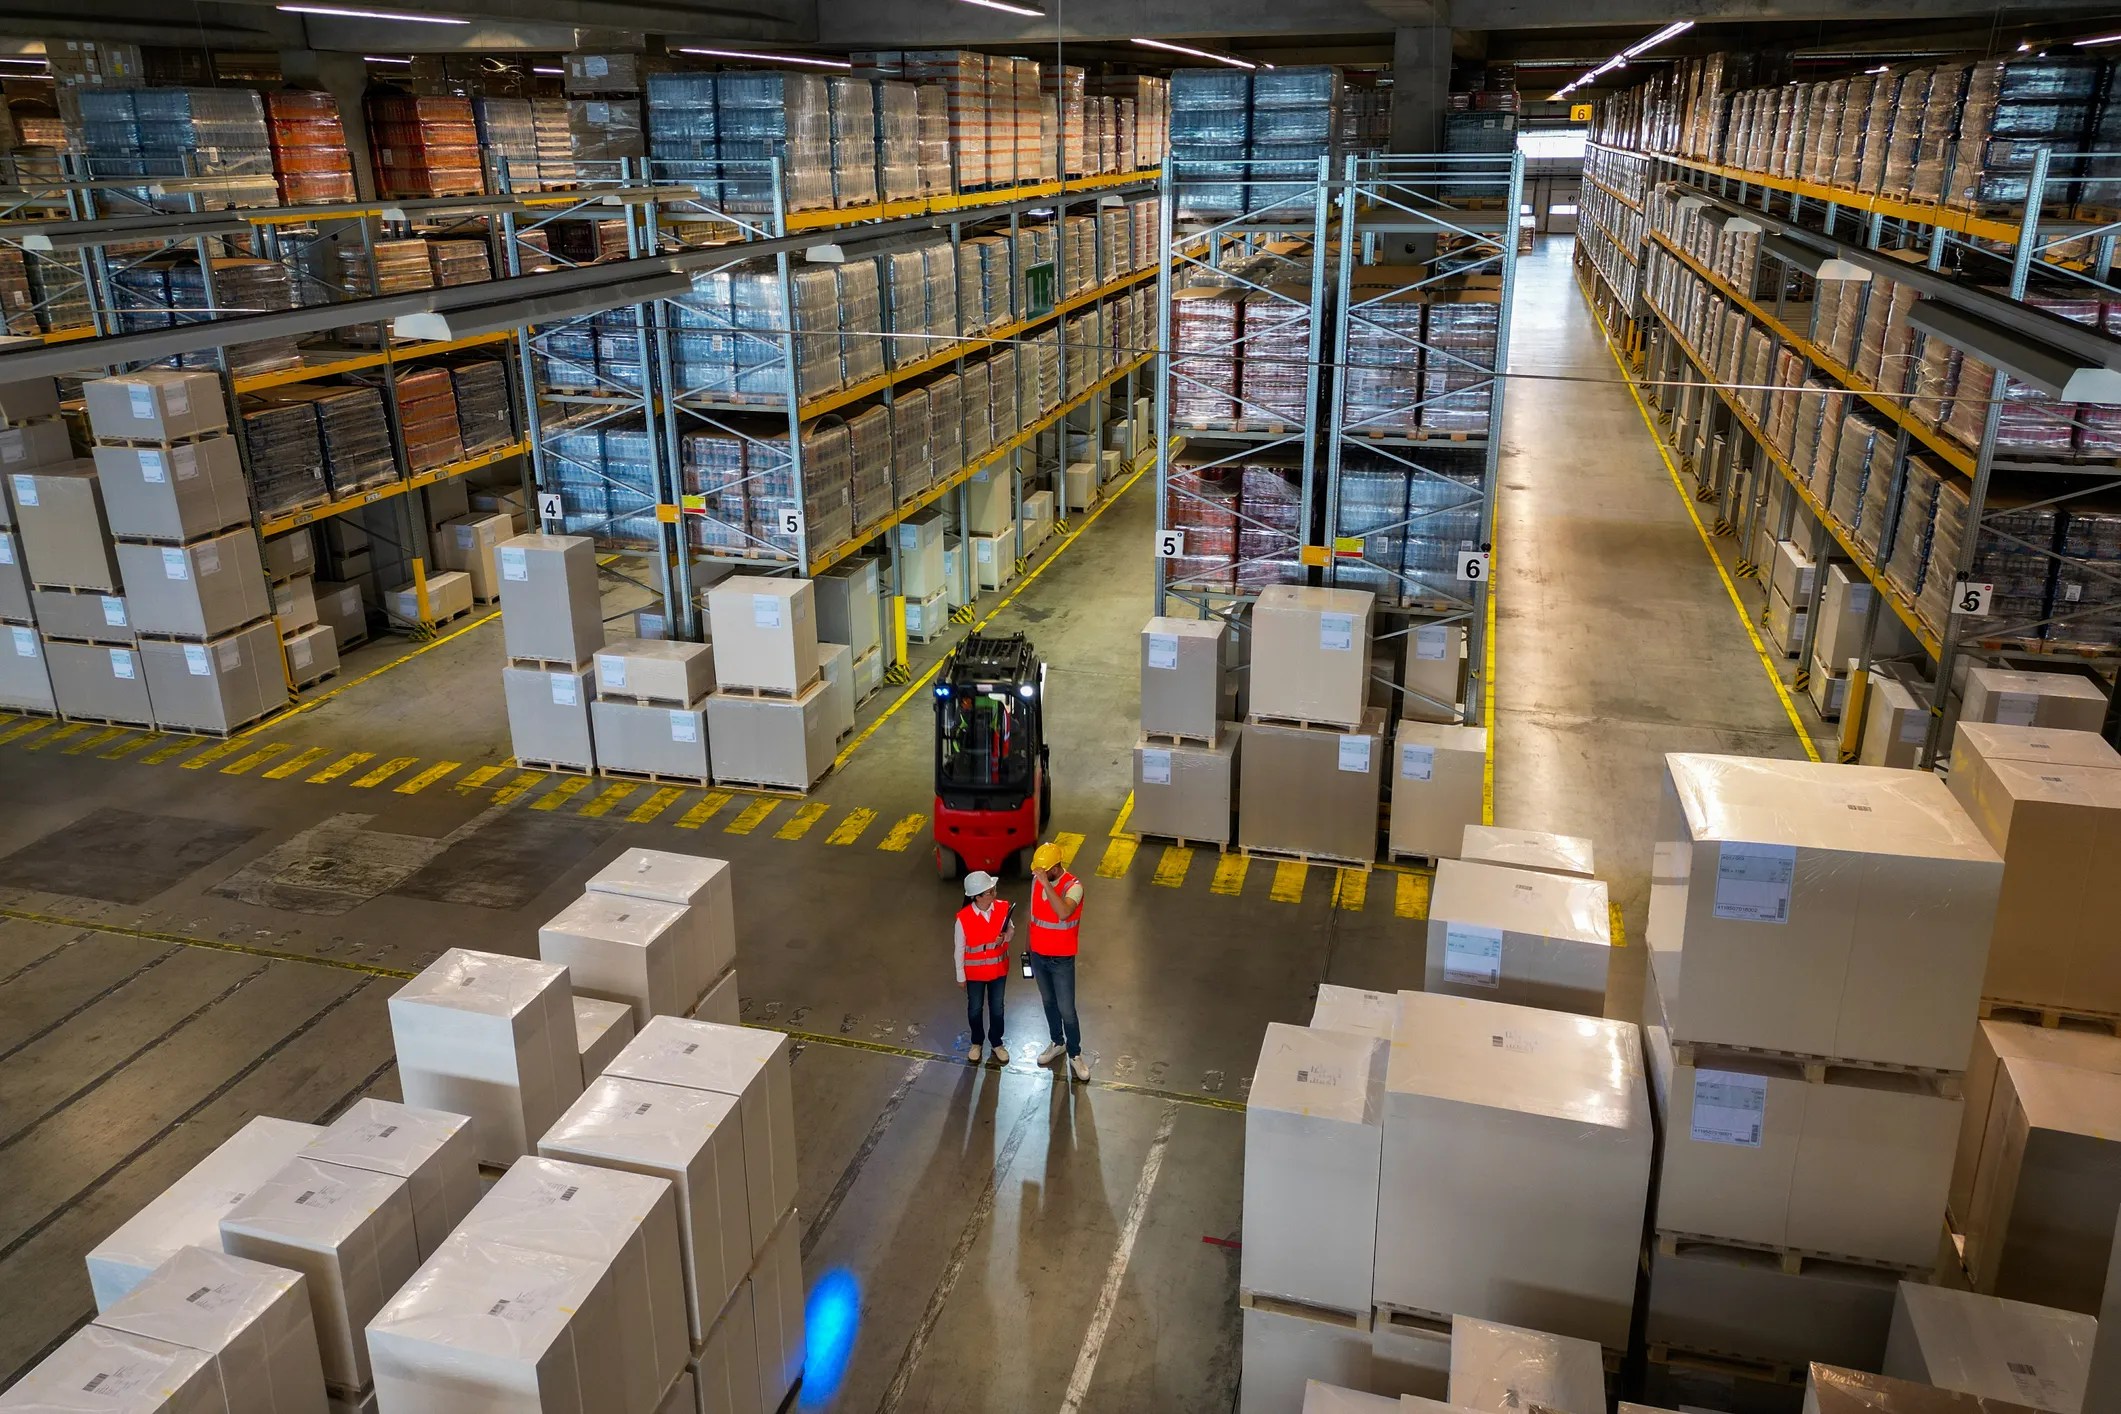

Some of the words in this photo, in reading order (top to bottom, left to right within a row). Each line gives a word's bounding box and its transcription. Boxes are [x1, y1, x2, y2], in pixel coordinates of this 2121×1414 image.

[1577, 109, 1585, 120] 6
[545, 500, 557, 517] 4
[787, 515, 798, 533] 5
[1163, 537, 1176, 555] 5
[1466, 559, 1480, 579] 6
[1963, 590, 1981, 612] 6
